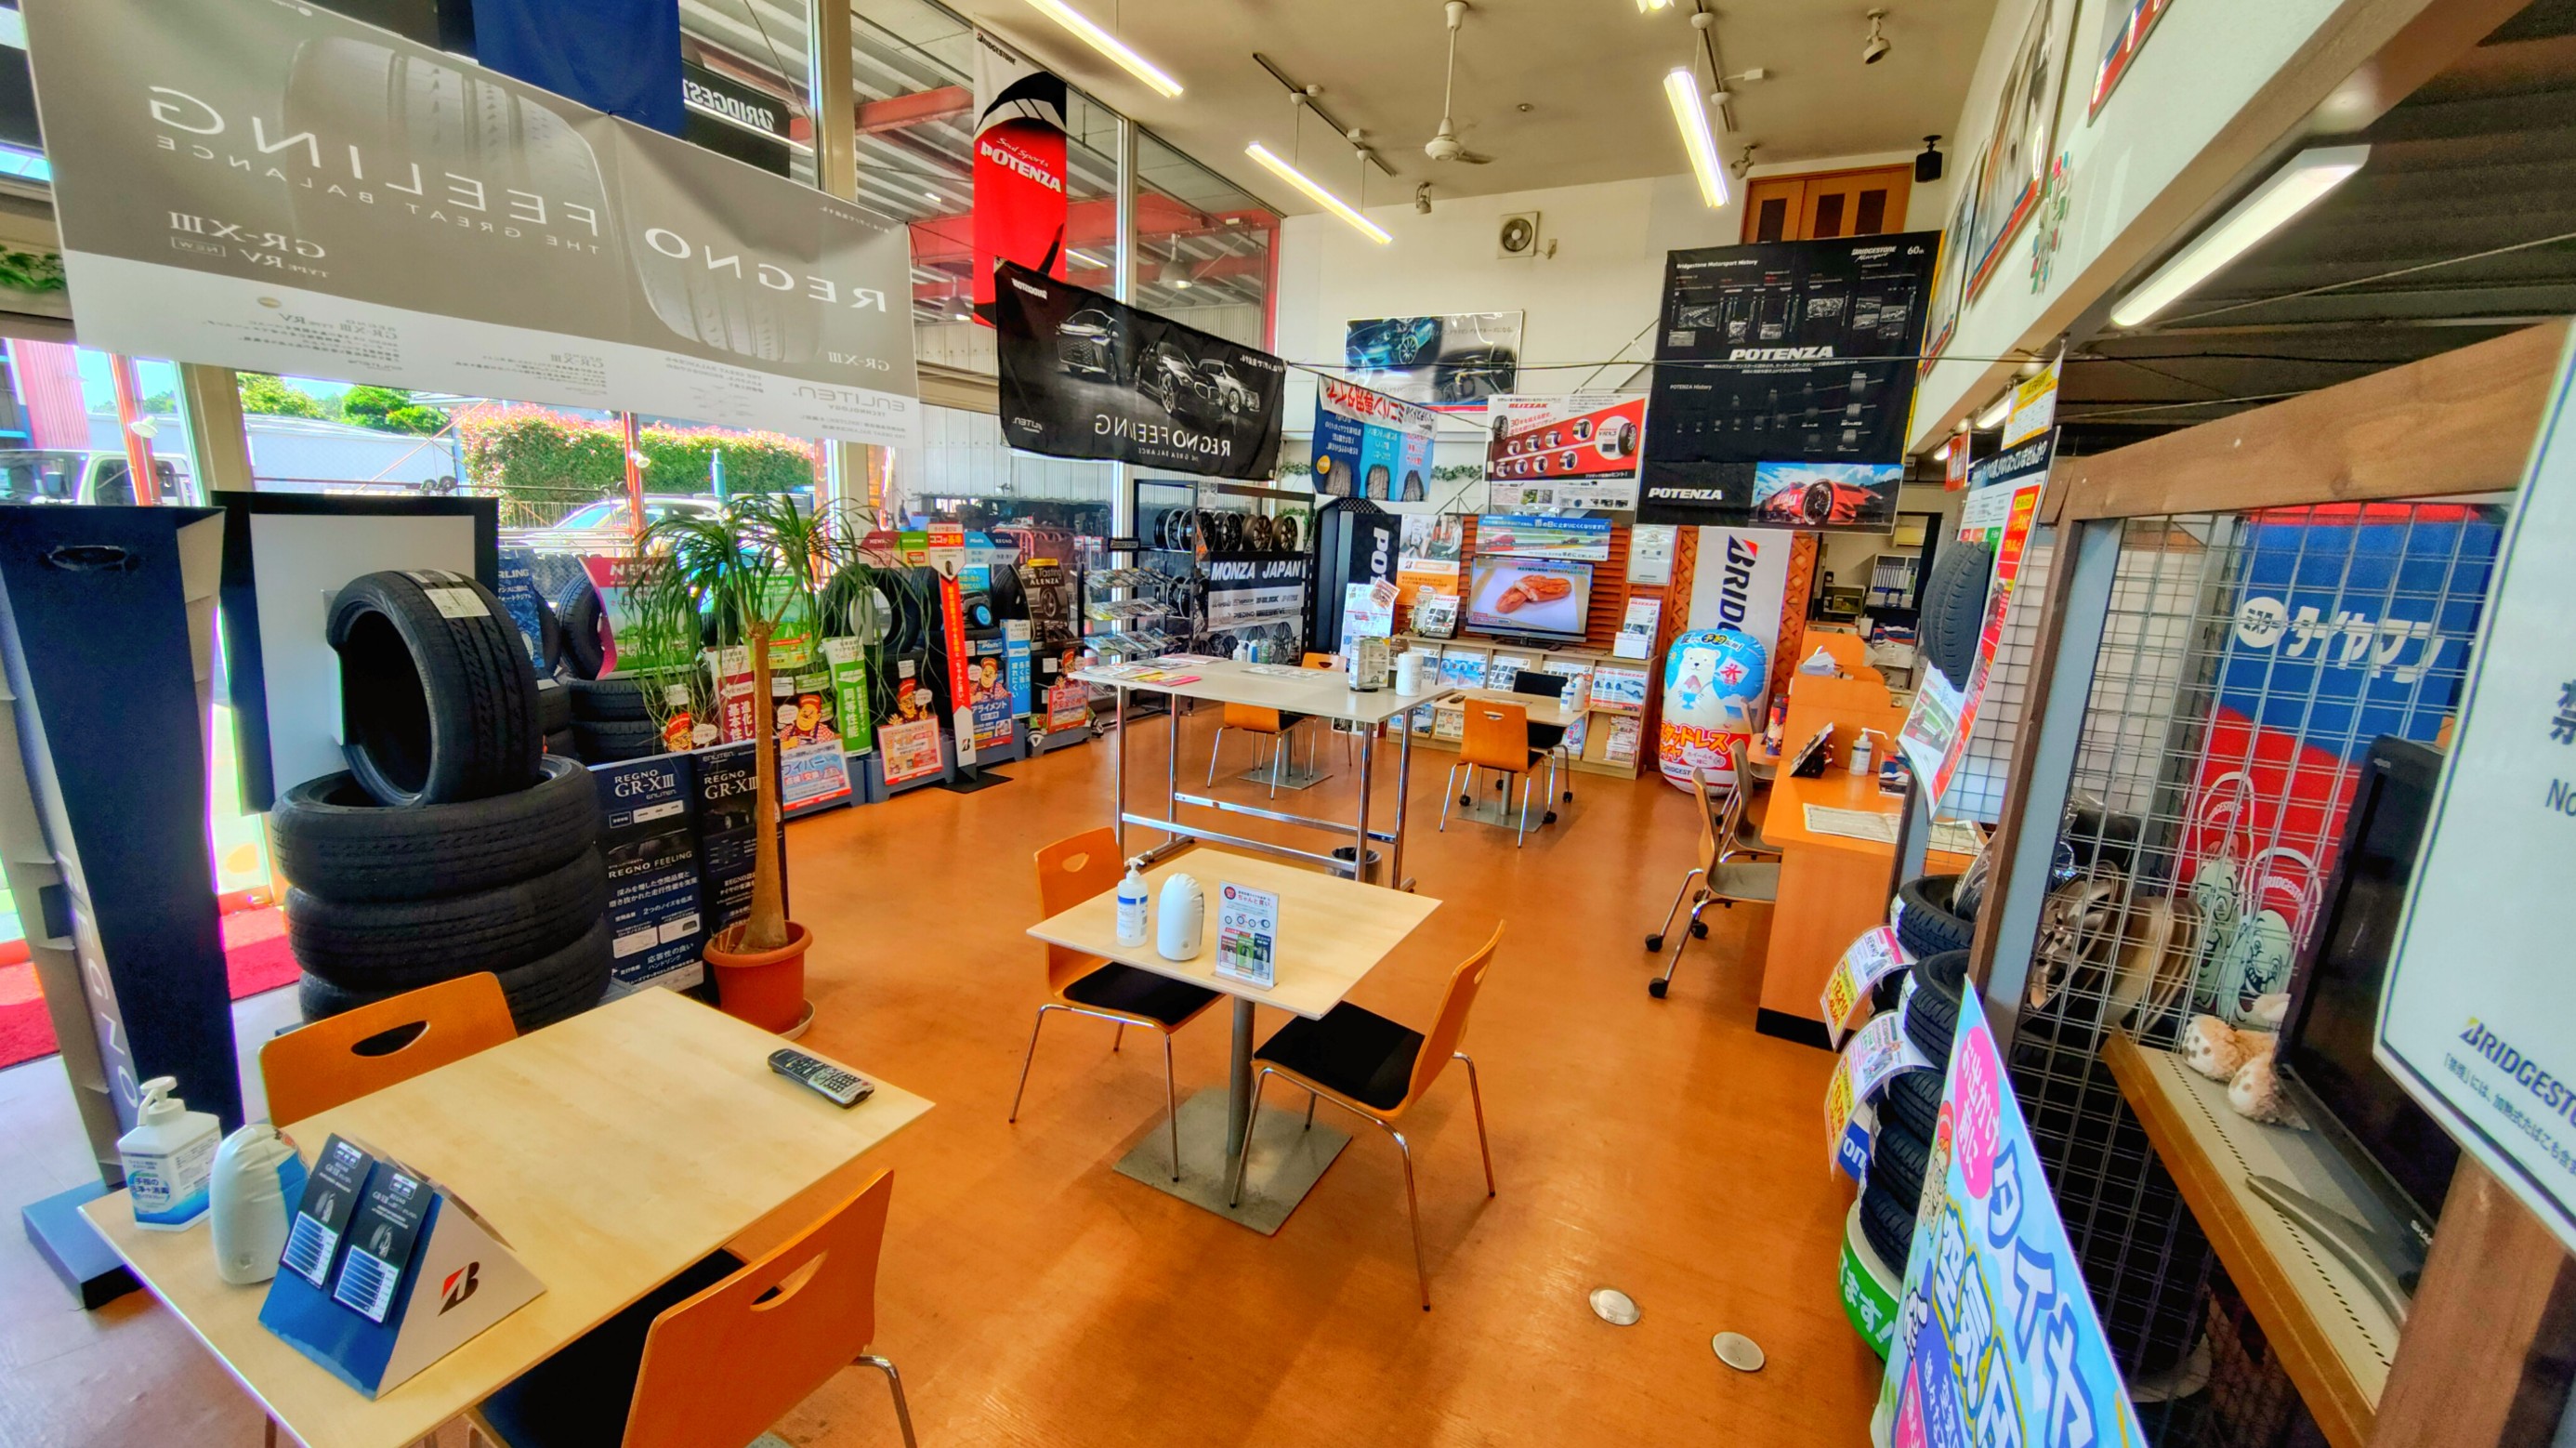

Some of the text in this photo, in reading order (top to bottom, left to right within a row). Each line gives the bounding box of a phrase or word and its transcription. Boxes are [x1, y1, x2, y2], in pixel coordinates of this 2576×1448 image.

[977, 33, 1016, 65] BRIDGESTONE
[980, 140, 1061, 193] POTENZA
[1851, 245, 1897, 256] BRIDGESTONE
[1676, 259, 1758, 270] Bridgestone Motorsport History
[1729, 346, 1833, 361] POTENZA
[1649, 487, 1723, 500] POTENZA
[1211, 560, 1301, 581] MONZA JAPAN
[614, 769, 659, 783] REGNO
[703, 770, 745, 784] REGNO
[609, 850, 693, 878] REGNO FEELING
[1962, 1030, 2001, 1157] お出かけ
